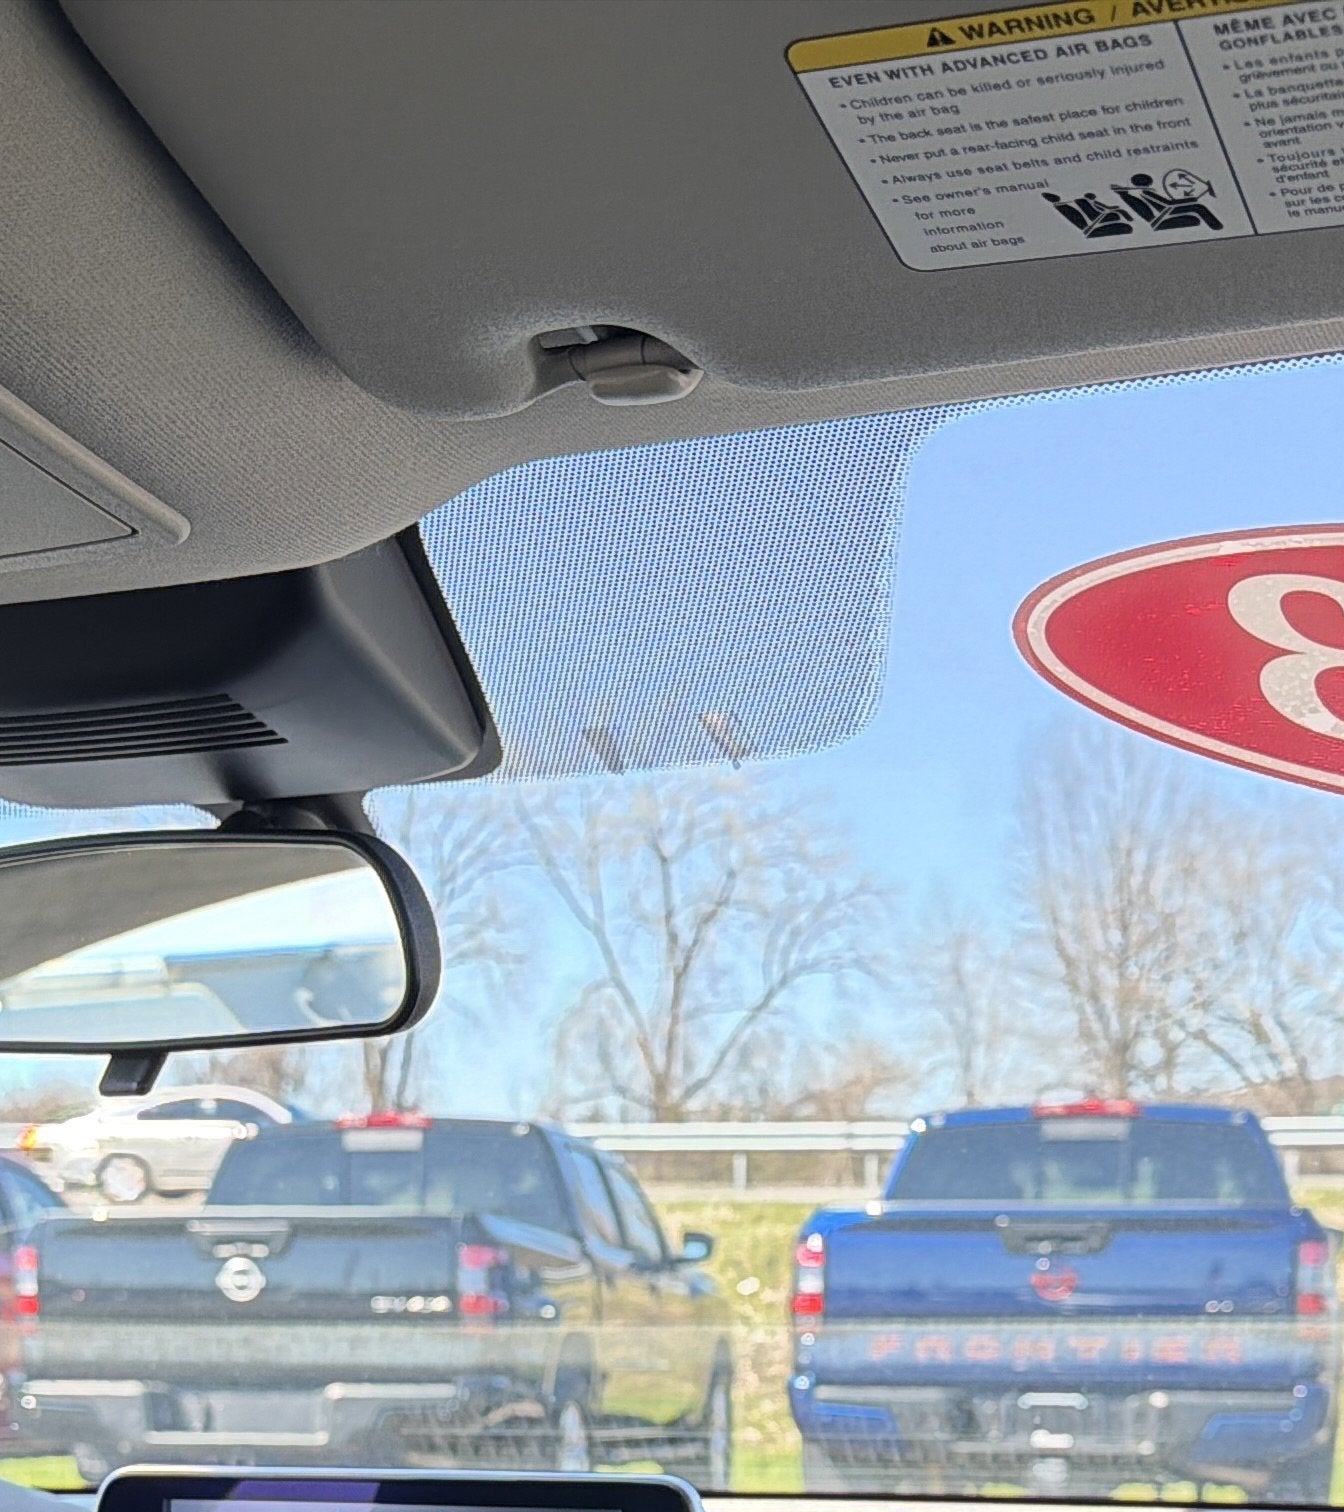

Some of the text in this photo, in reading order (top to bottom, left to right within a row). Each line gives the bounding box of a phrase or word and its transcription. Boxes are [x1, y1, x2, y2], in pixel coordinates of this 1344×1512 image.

[958, 8, 1095, 41] WARNING
[1213, 16, 1275, 36] MÊME
[1282, 8, 1336, 27] AVEC
[1219, 25, 1343, 51] GONFLABLES
[829, 34, 1152, 88] EVEN WITH ADVANCED AIR BAGS
[1269, 51, 1329, 65] enfants
[849, 59, 1165, 110] Children can be killed or seriously injured
[858, 104, 960, 126] by the air bag
[866, 97, 1184, 145] The back seat is the safest place for children
[879, 117, 1192, 165] Never put a rear-facing child seat in the front
[892, 139, 1199, 185] Always use seat belts and child restraints
[902, 179, 1049, 205] See owner's manual
[1280, 186, 1312, 197] Pour
[1316, 183, 1335, 193] de
[915, 206, 975, 221] for more
[923, 220, 1005, 236] information
[930, 234, 1025, 254] about air bags
[868, 1333, 1244, 1364] FRONTIER
